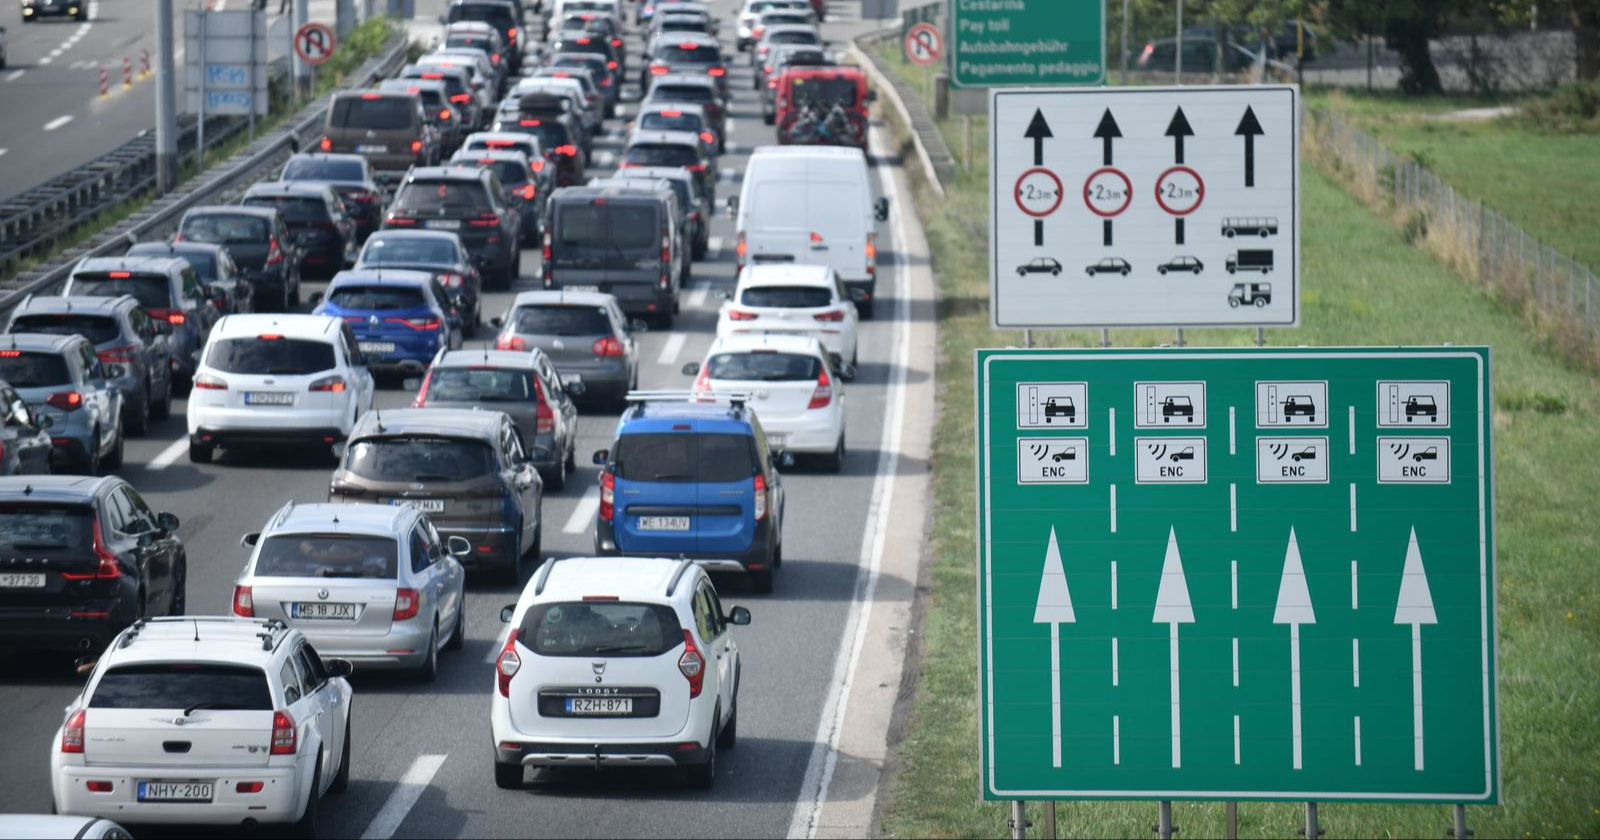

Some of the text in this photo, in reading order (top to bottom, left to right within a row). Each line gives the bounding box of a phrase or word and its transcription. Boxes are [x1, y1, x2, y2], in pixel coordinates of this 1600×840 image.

[960, 19, 1010, 33] Pay toll
[960, 39, 1068, 54] Autobahngebühr
[960, 61, 1099, 77] Pagamento pedaggio
[1042, 467, 1065, 477] ENC
[1160, 466, 1183, 477] ENC
[1281, 466, 1305, 476] ENC
[1402, 466, 1426, 476] ENC
[299, 604, 350, 616] MS 18 JJX
[578, 687, 620, 695] LODGY
[574, 700, 630, 712] RZH-871
[148, 784, 210, 798] NHY-200
